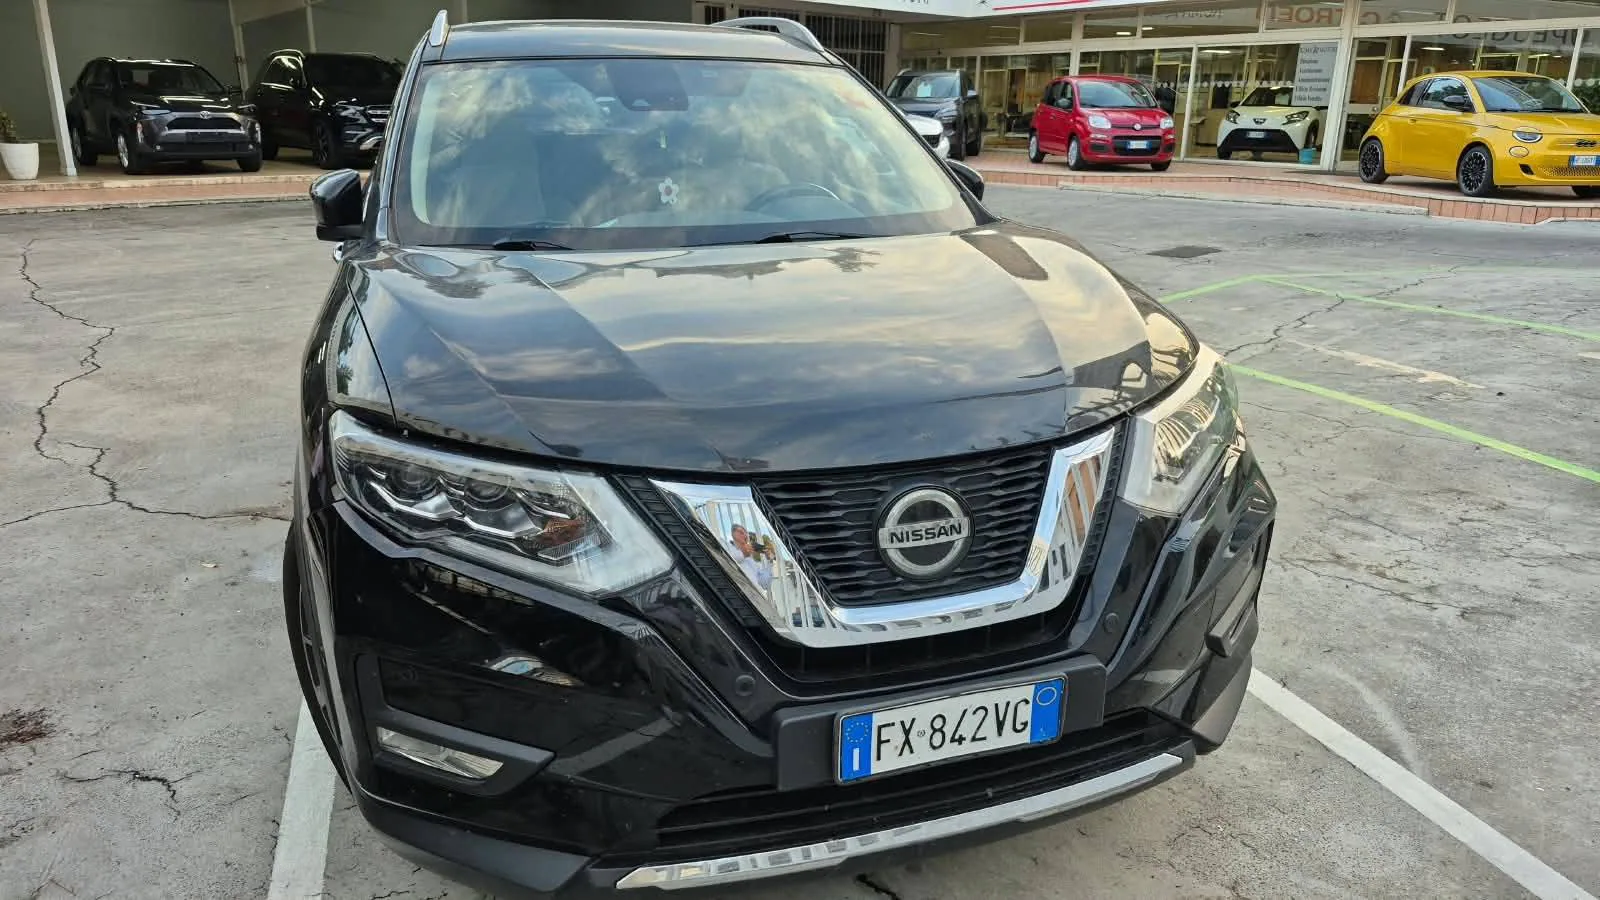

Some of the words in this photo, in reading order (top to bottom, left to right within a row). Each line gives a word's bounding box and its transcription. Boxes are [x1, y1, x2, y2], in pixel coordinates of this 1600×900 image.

[890, 523, 962, 544] NISSAN
[875, 717, 917, 761] FX
[929, 698, 1030, 750] 842VG
